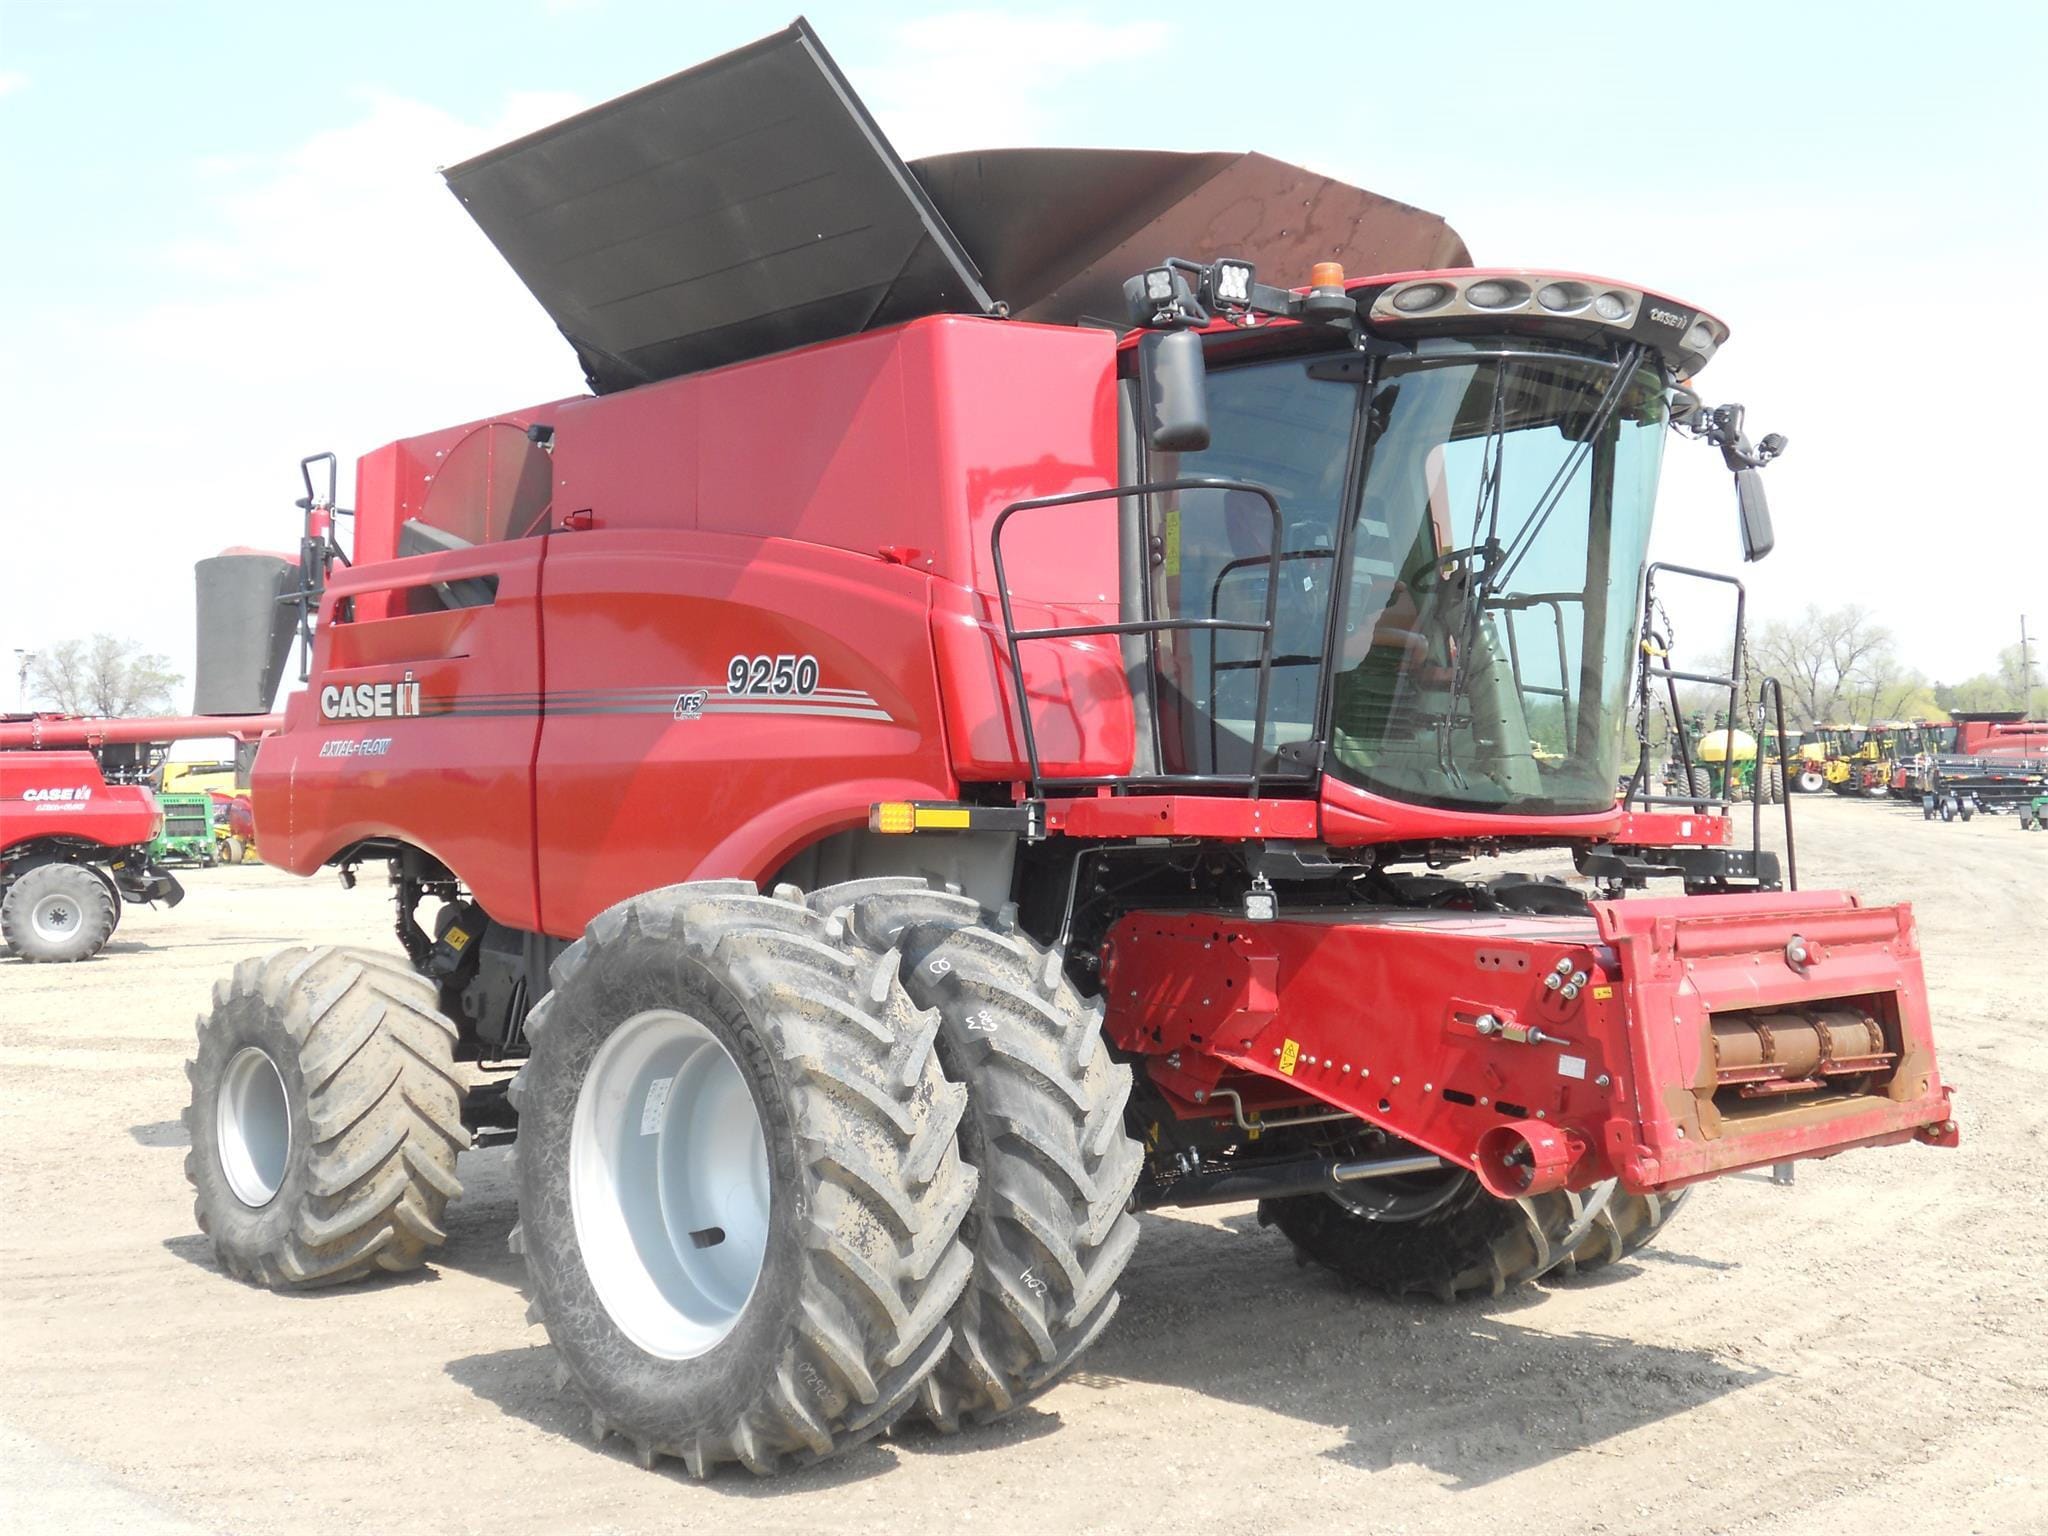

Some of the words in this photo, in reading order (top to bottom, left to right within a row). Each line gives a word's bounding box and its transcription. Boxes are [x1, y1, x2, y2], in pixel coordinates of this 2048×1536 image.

[727, 654, 819, 697] 9250
[321, 684, 392, 719] CASE
[675, 694, 701, 711] AFS
[22, 788, 75, 802] CASE
